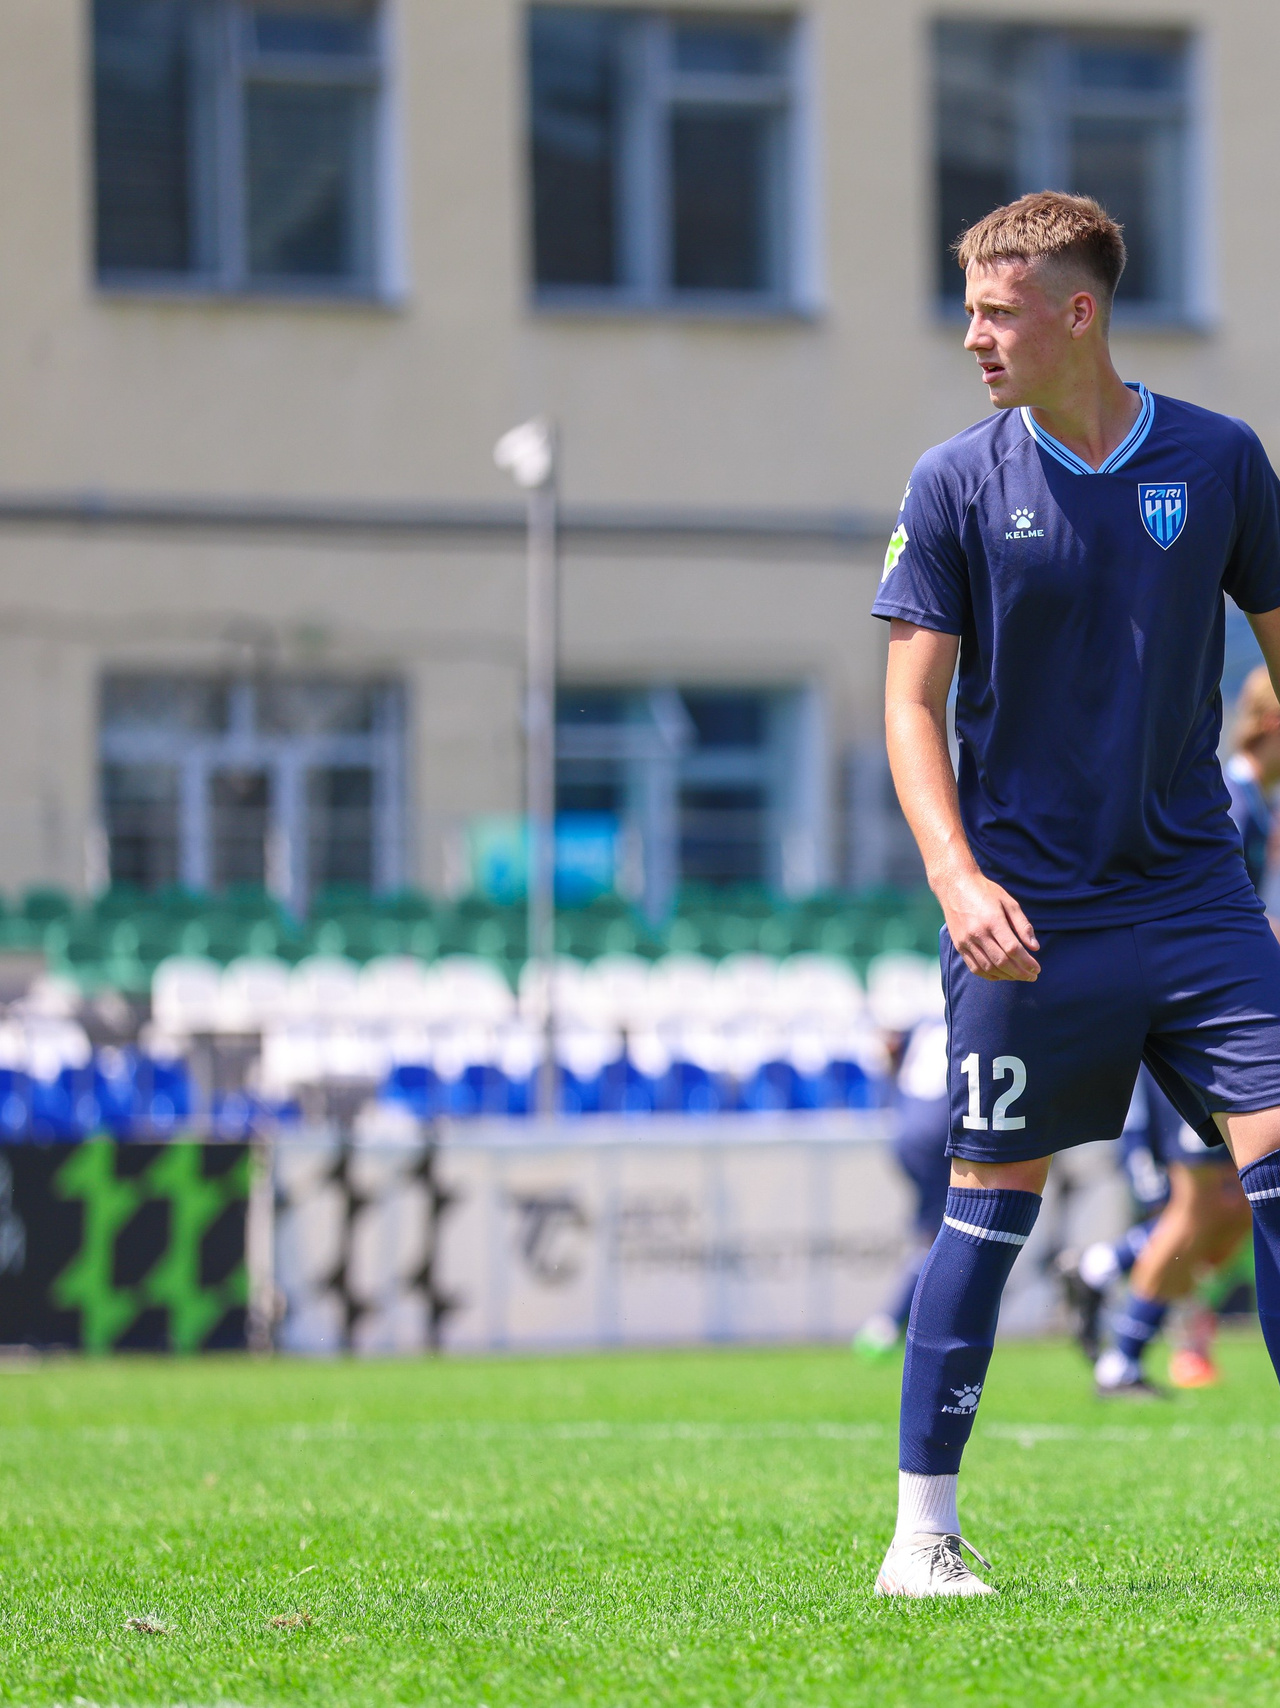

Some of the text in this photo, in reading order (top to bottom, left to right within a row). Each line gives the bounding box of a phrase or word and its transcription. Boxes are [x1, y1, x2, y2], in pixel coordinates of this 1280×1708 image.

[1145, 488, 1181, 499] PARI
[1005, 529, 1045, 540] KELME
[960, 1052, 1027, 1131] 12
[941, 1403, 979, 1415] KELM
